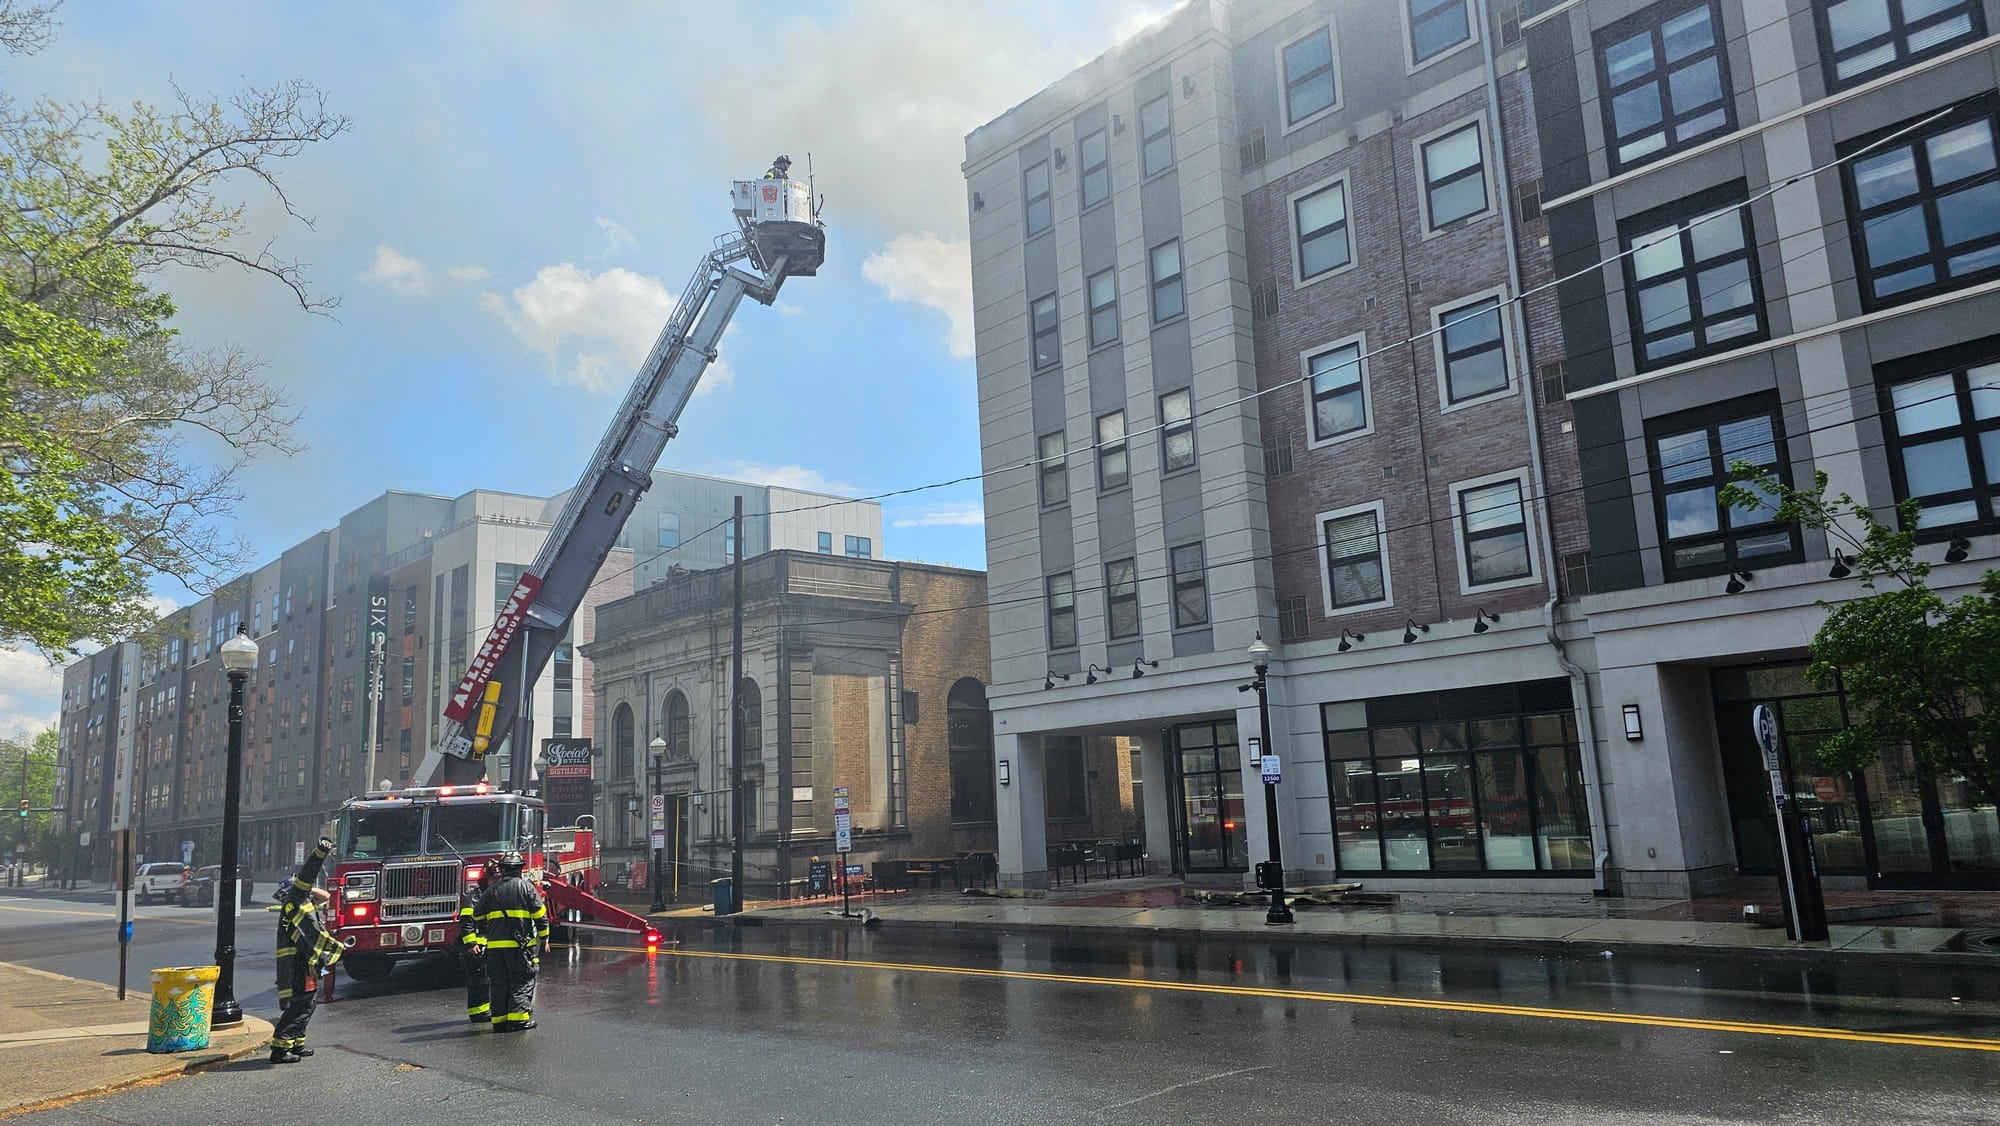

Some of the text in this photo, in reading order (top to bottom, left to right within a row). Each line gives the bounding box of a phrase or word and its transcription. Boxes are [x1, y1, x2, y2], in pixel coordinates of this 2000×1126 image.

[371, 596, 386, 626] SIX
[453, 584, 531, 709] ALLENTOWN
[477, 661, 494, 684] FIRE
[496, 615, 521, 651] RESCUE
[547, 743, 590, 767] Social
[549, 767, 587, 775] DISTILLERY
